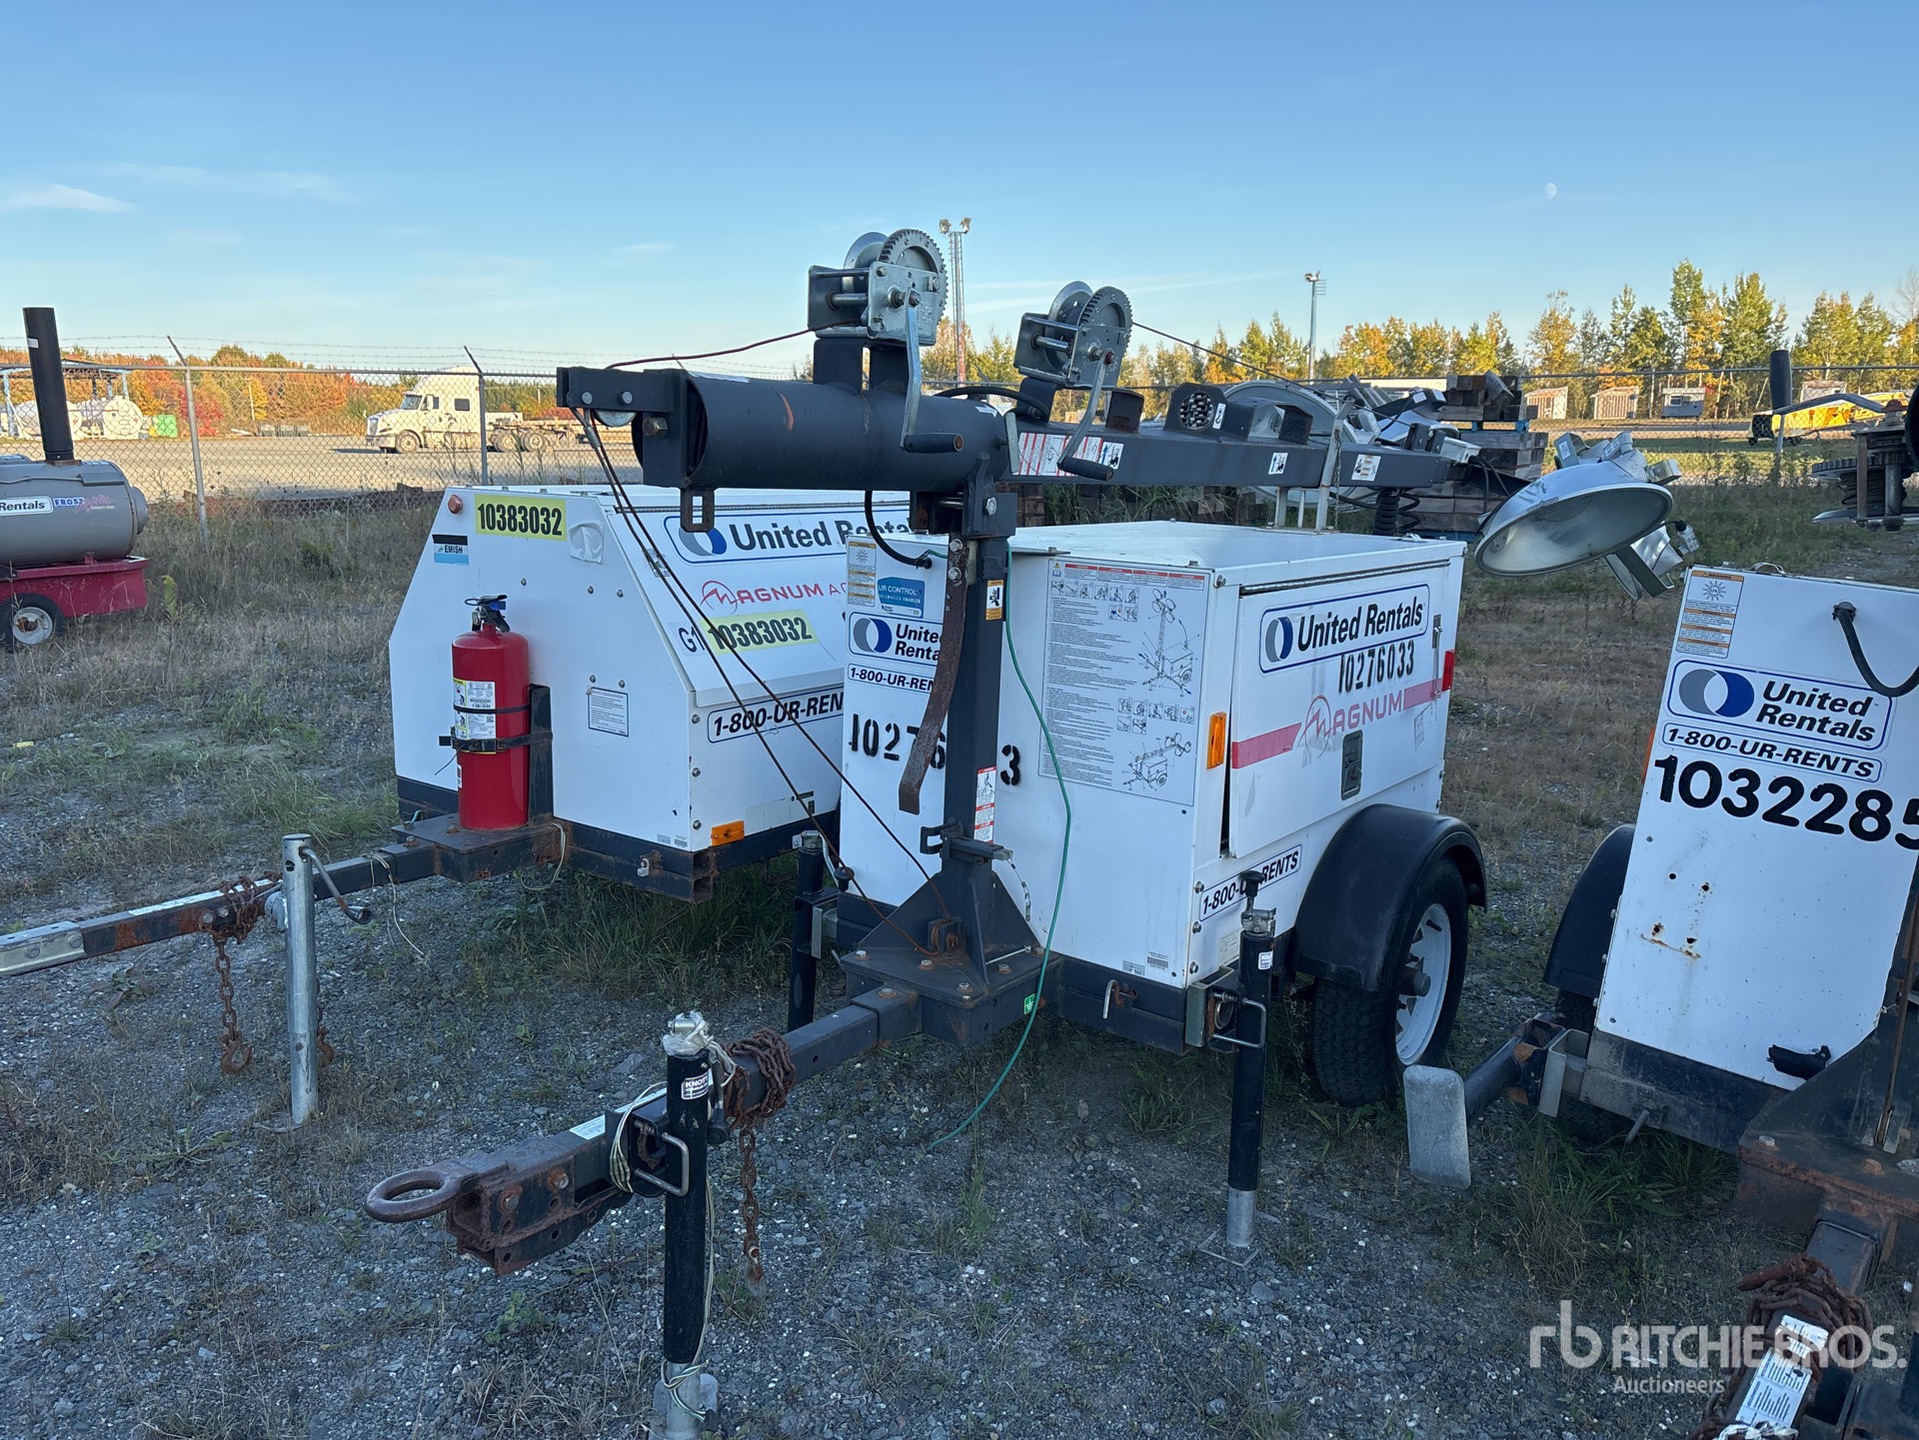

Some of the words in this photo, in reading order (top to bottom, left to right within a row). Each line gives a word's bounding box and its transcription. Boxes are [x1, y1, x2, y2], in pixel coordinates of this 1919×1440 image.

[477, 503, 563, 537] 10383032
[728, 521, 832, 551] United
[888, 585, 918, 596] CONTROL
[707, 616, 813, 651] 10383032
[1297, 605, 1362, 652] United
[1364, 596, 1424, 638] Rentals
[1338, 639, 1416, 694] 10276033
[1762, 680, 1874, 717] United
[1755, 703, 1876, 742] Rentals
[1668, 728, 1874, 778] 1-800-UR-RENTS
